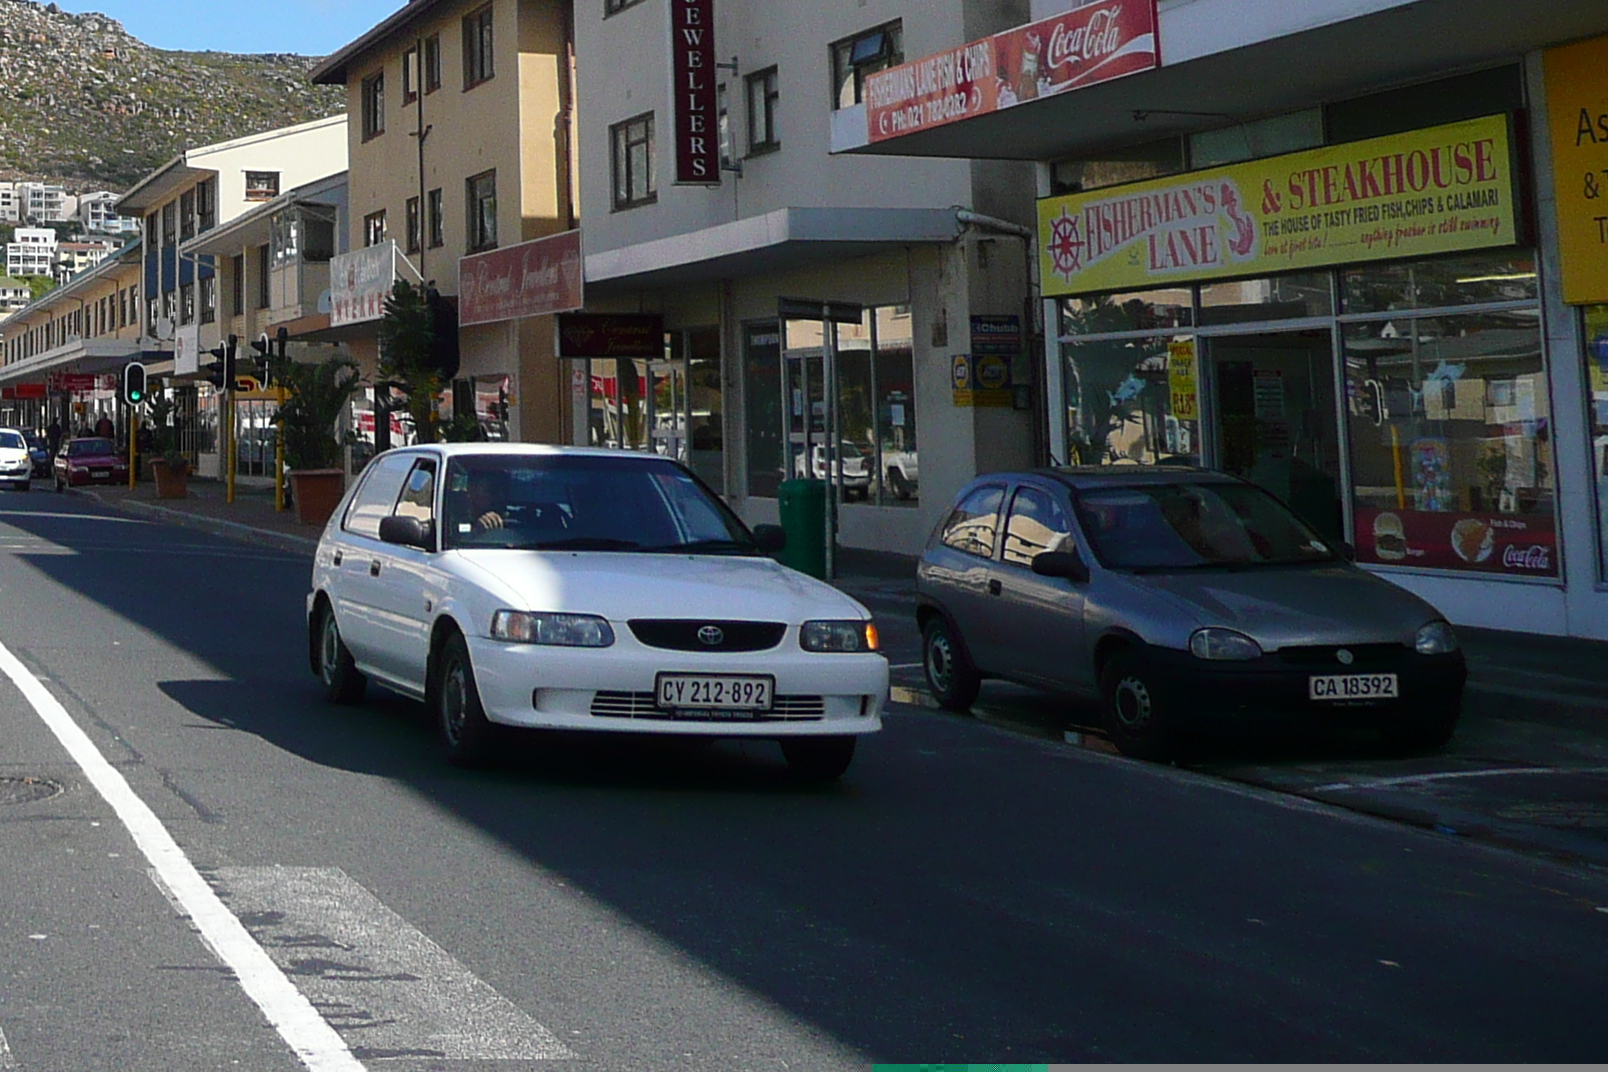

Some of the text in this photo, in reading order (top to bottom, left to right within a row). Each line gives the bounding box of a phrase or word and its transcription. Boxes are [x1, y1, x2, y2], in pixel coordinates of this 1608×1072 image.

[915, 60, 937, 97] LANE
[937, 52, 954, 90] FISH
[956, 49, 964, 85] &
[965, 41, 990, 83] CHIPS
[908, 103, 924, 128] 021
[1261, 138, 1497, 215] & STEAKHOUSE
[1583, 172, 1599, 200] &
[1085, 184, 1216, 262] FISHERMAN'S
[1262, 221, 1280, 237] THE
[1281, 215, 1310, 235] HOUSE
[1310, 214, 1322, 230] OF
[1323, 208, 1352, 228] TASTY
[1353, 204, 1380, 224] FRIED
[1437, 196, 1445, 213] &
[1446, 188, 1499, 212] CALAMARI
[1148, 225, 1217, 271] LANE
[982, 323, 1018, 332] Chubb
[663, 681, 766, 704] CY 212-892
[1314, 676, 1394, 696] CA 18392
